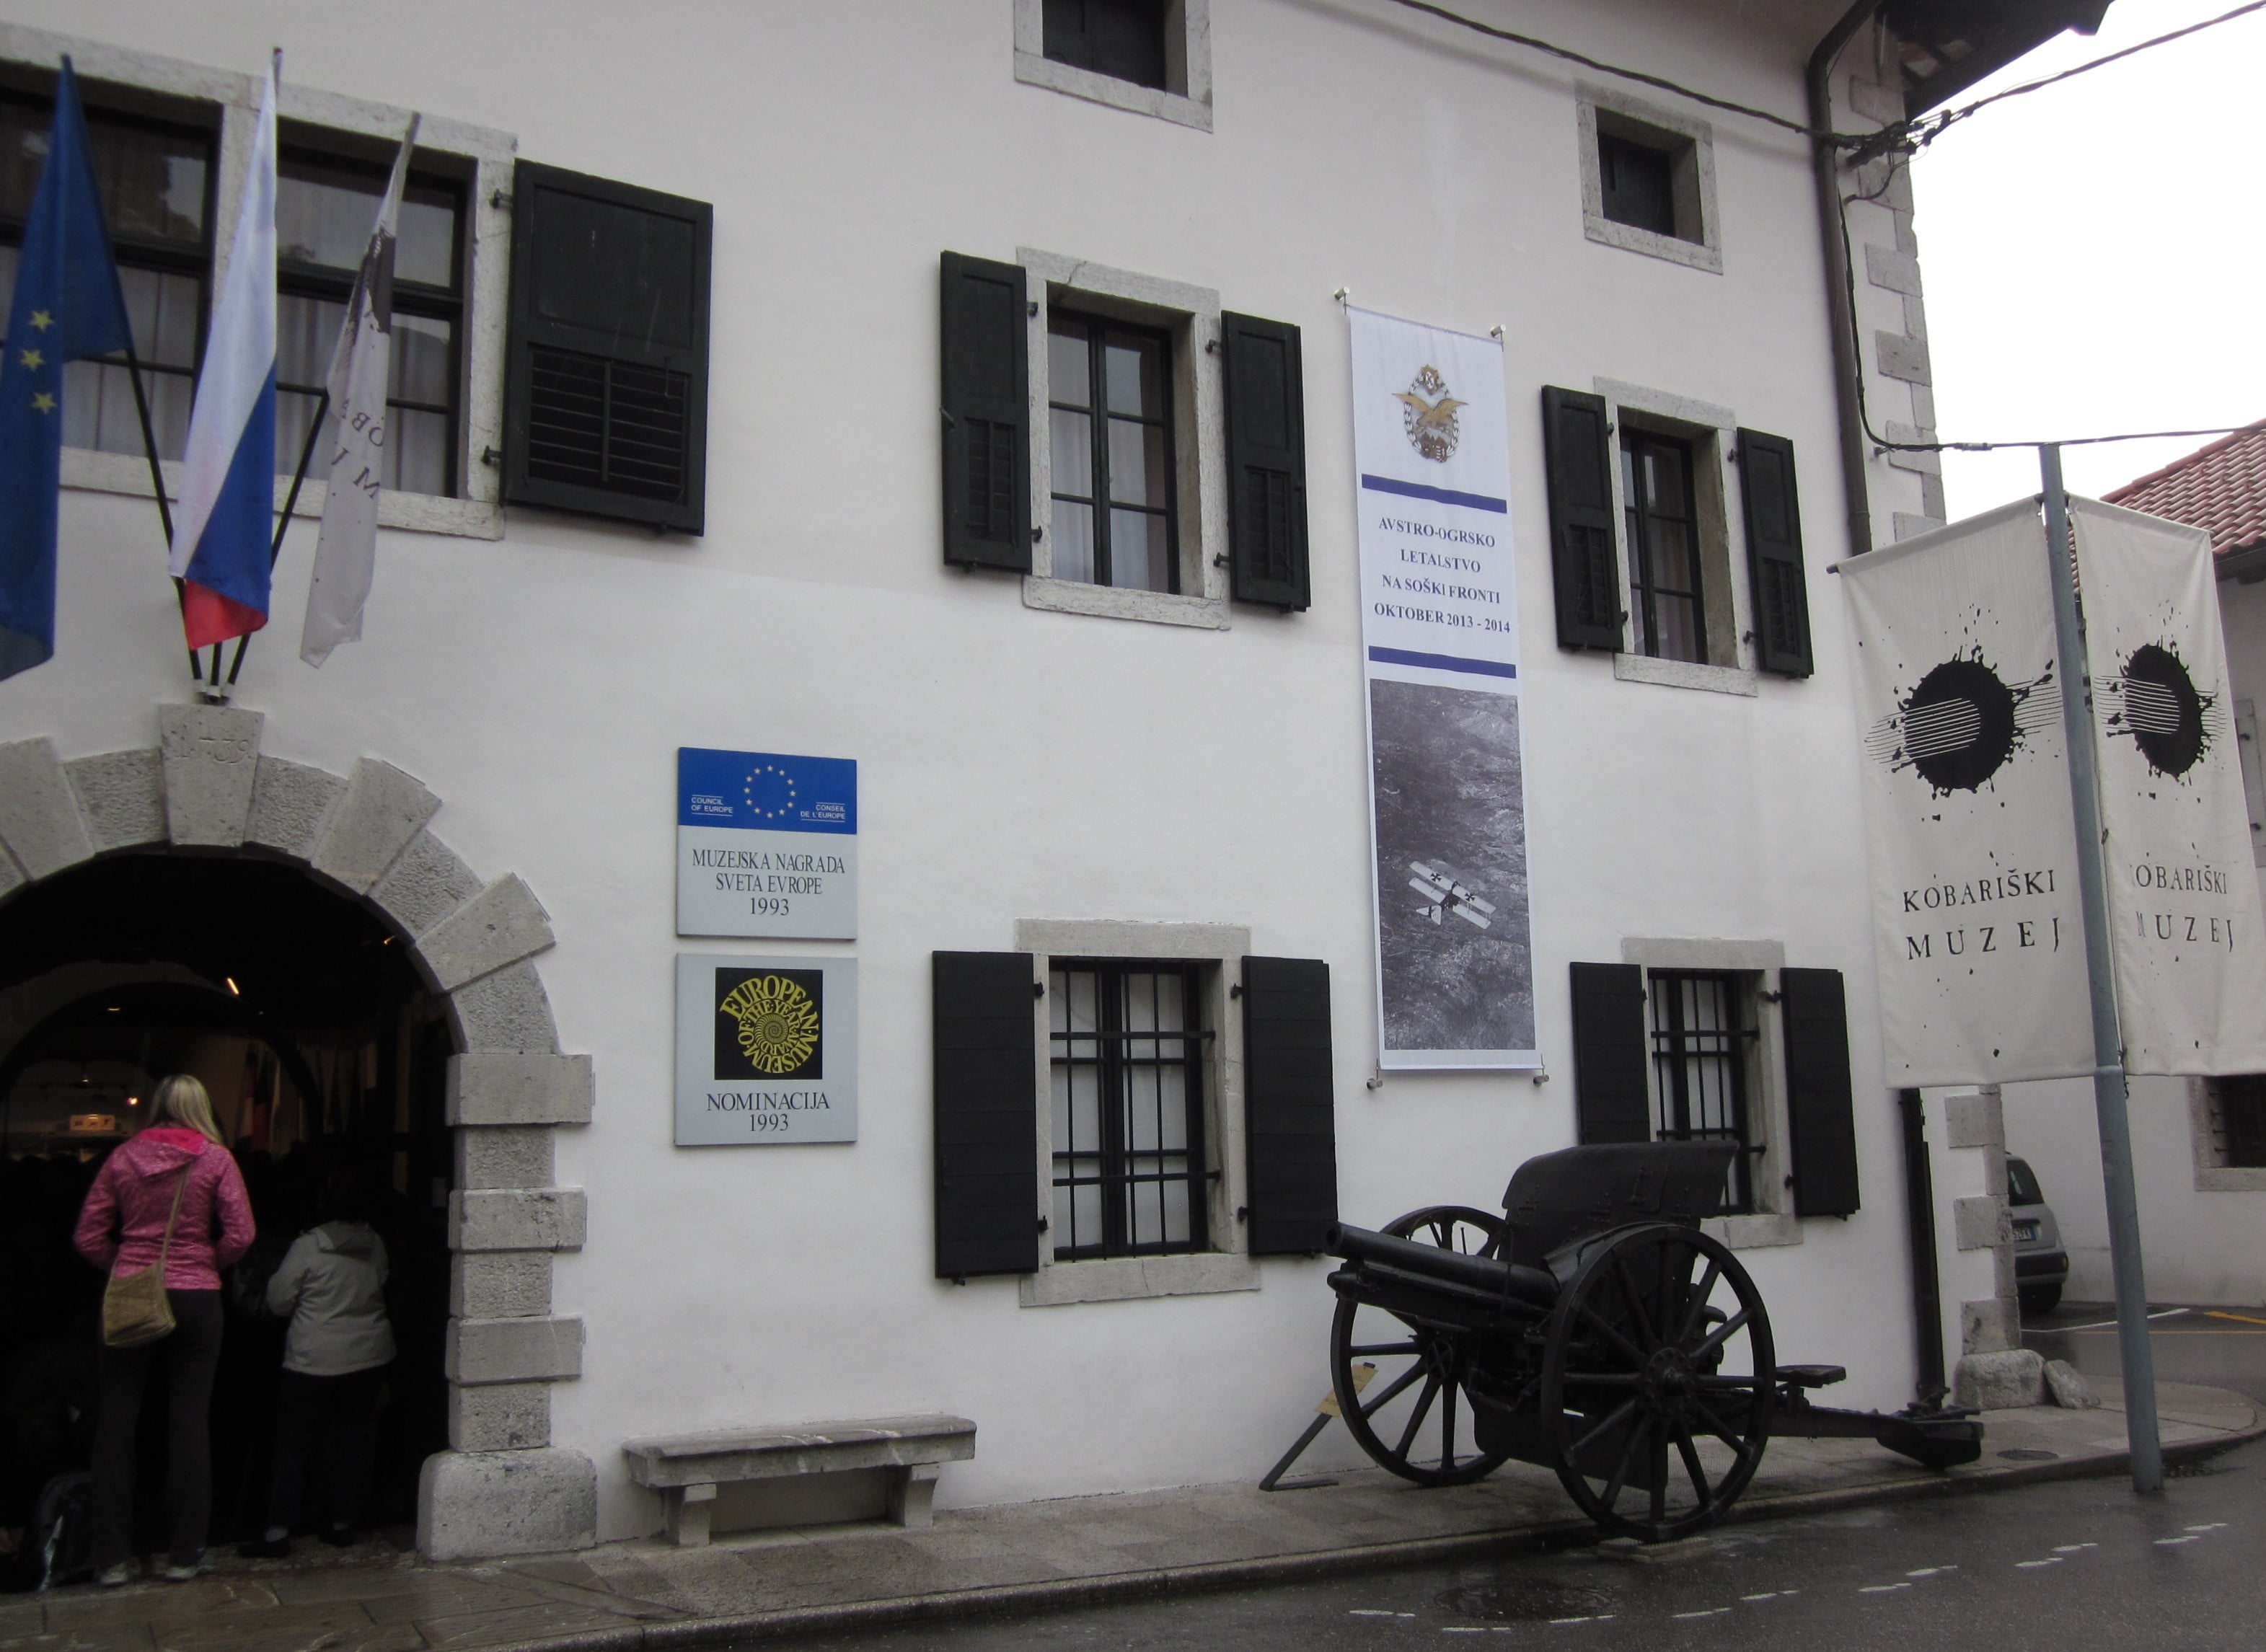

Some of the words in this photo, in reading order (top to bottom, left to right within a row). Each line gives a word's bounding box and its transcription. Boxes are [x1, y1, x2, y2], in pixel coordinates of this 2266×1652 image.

[1379, 517, 1495, 547] AVSTRO-OGRSKO
[1401, 549, 1481, 573] LETALSTVO
[1382, 575, 1401, 590] NA
[1404, 578, 1445, 596] SOŠKI
[1449, 586, 1500, 604] FRONTI
[1374, 603, 1445, 624] OKTOBER
[1447, 613, 1473, 628] 2013
[1485, 618, 1510, 633] 2014
[812, 811, 845, 820] L'EUROPE
[692, 849, 770, 870] MUZEJSKA
[775, 853, 845, 873] NAGRADA
[715, 873, 762, 892] SVETA
[768, 876, 822, 894] EVROPE
[1903, 867, 2055, 913] KOBARIŠKI
[2129, 865, 2227, 894] OBARIŠKI
[750, 897, 789, 916] 1993
[1906, 917, 2059, 960] MUZEJ
[706, 1092, 829, 1111] NOMINACIJA
[750, 1113, 789, 1131] 1993
